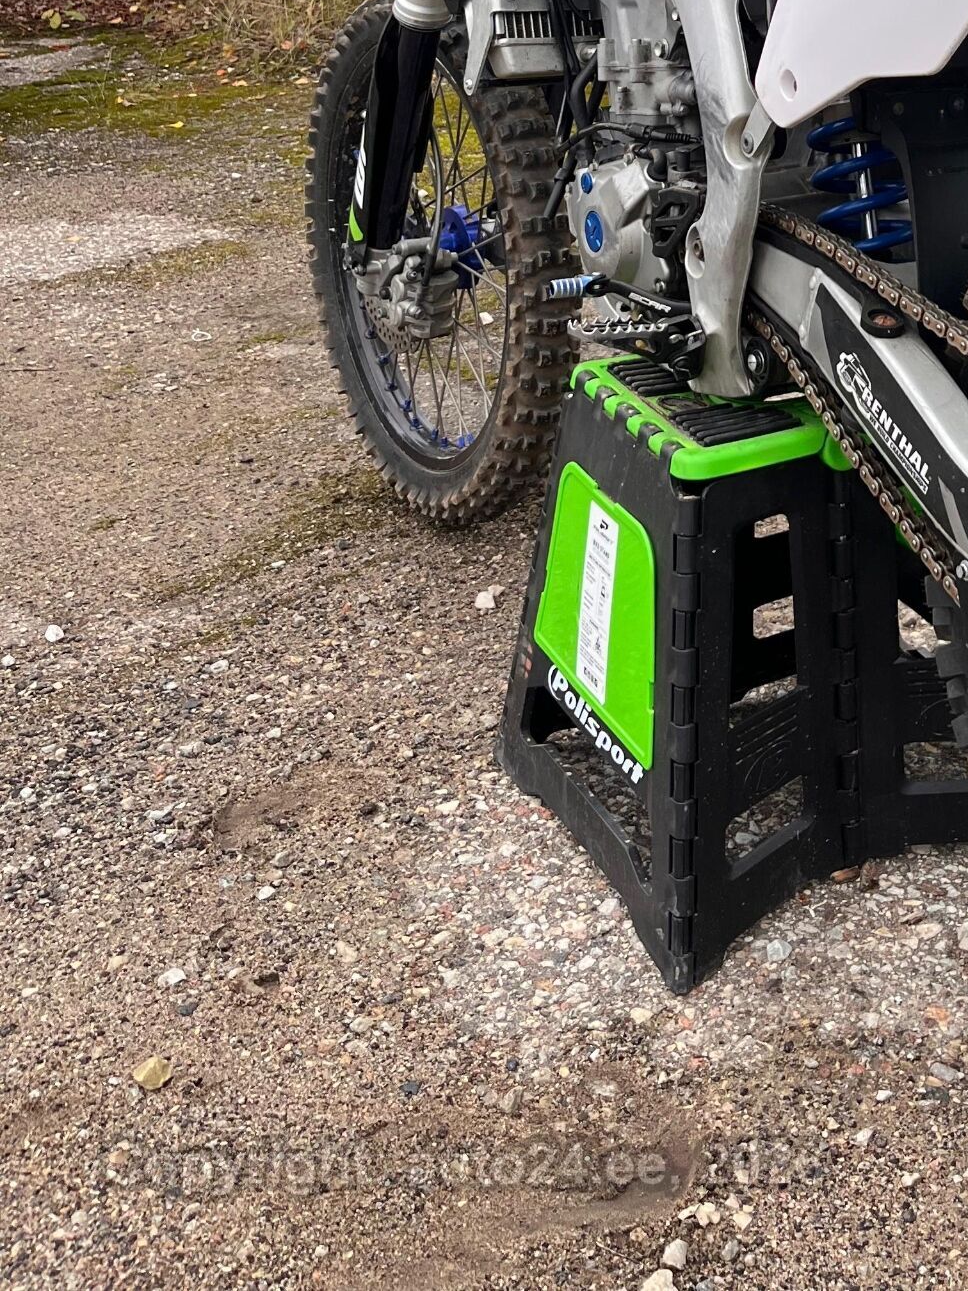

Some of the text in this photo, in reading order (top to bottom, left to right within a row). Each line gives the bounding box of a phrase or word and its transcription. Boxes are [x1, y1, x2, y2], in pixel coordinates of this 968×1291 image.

[628, 292, 672, 314] SCAR
[860, 389, 931, 485] RENTHAL
[888, 440, 929, 494] CHAMPIONSHIPS
[549, 666, 644, 784] Polisport
